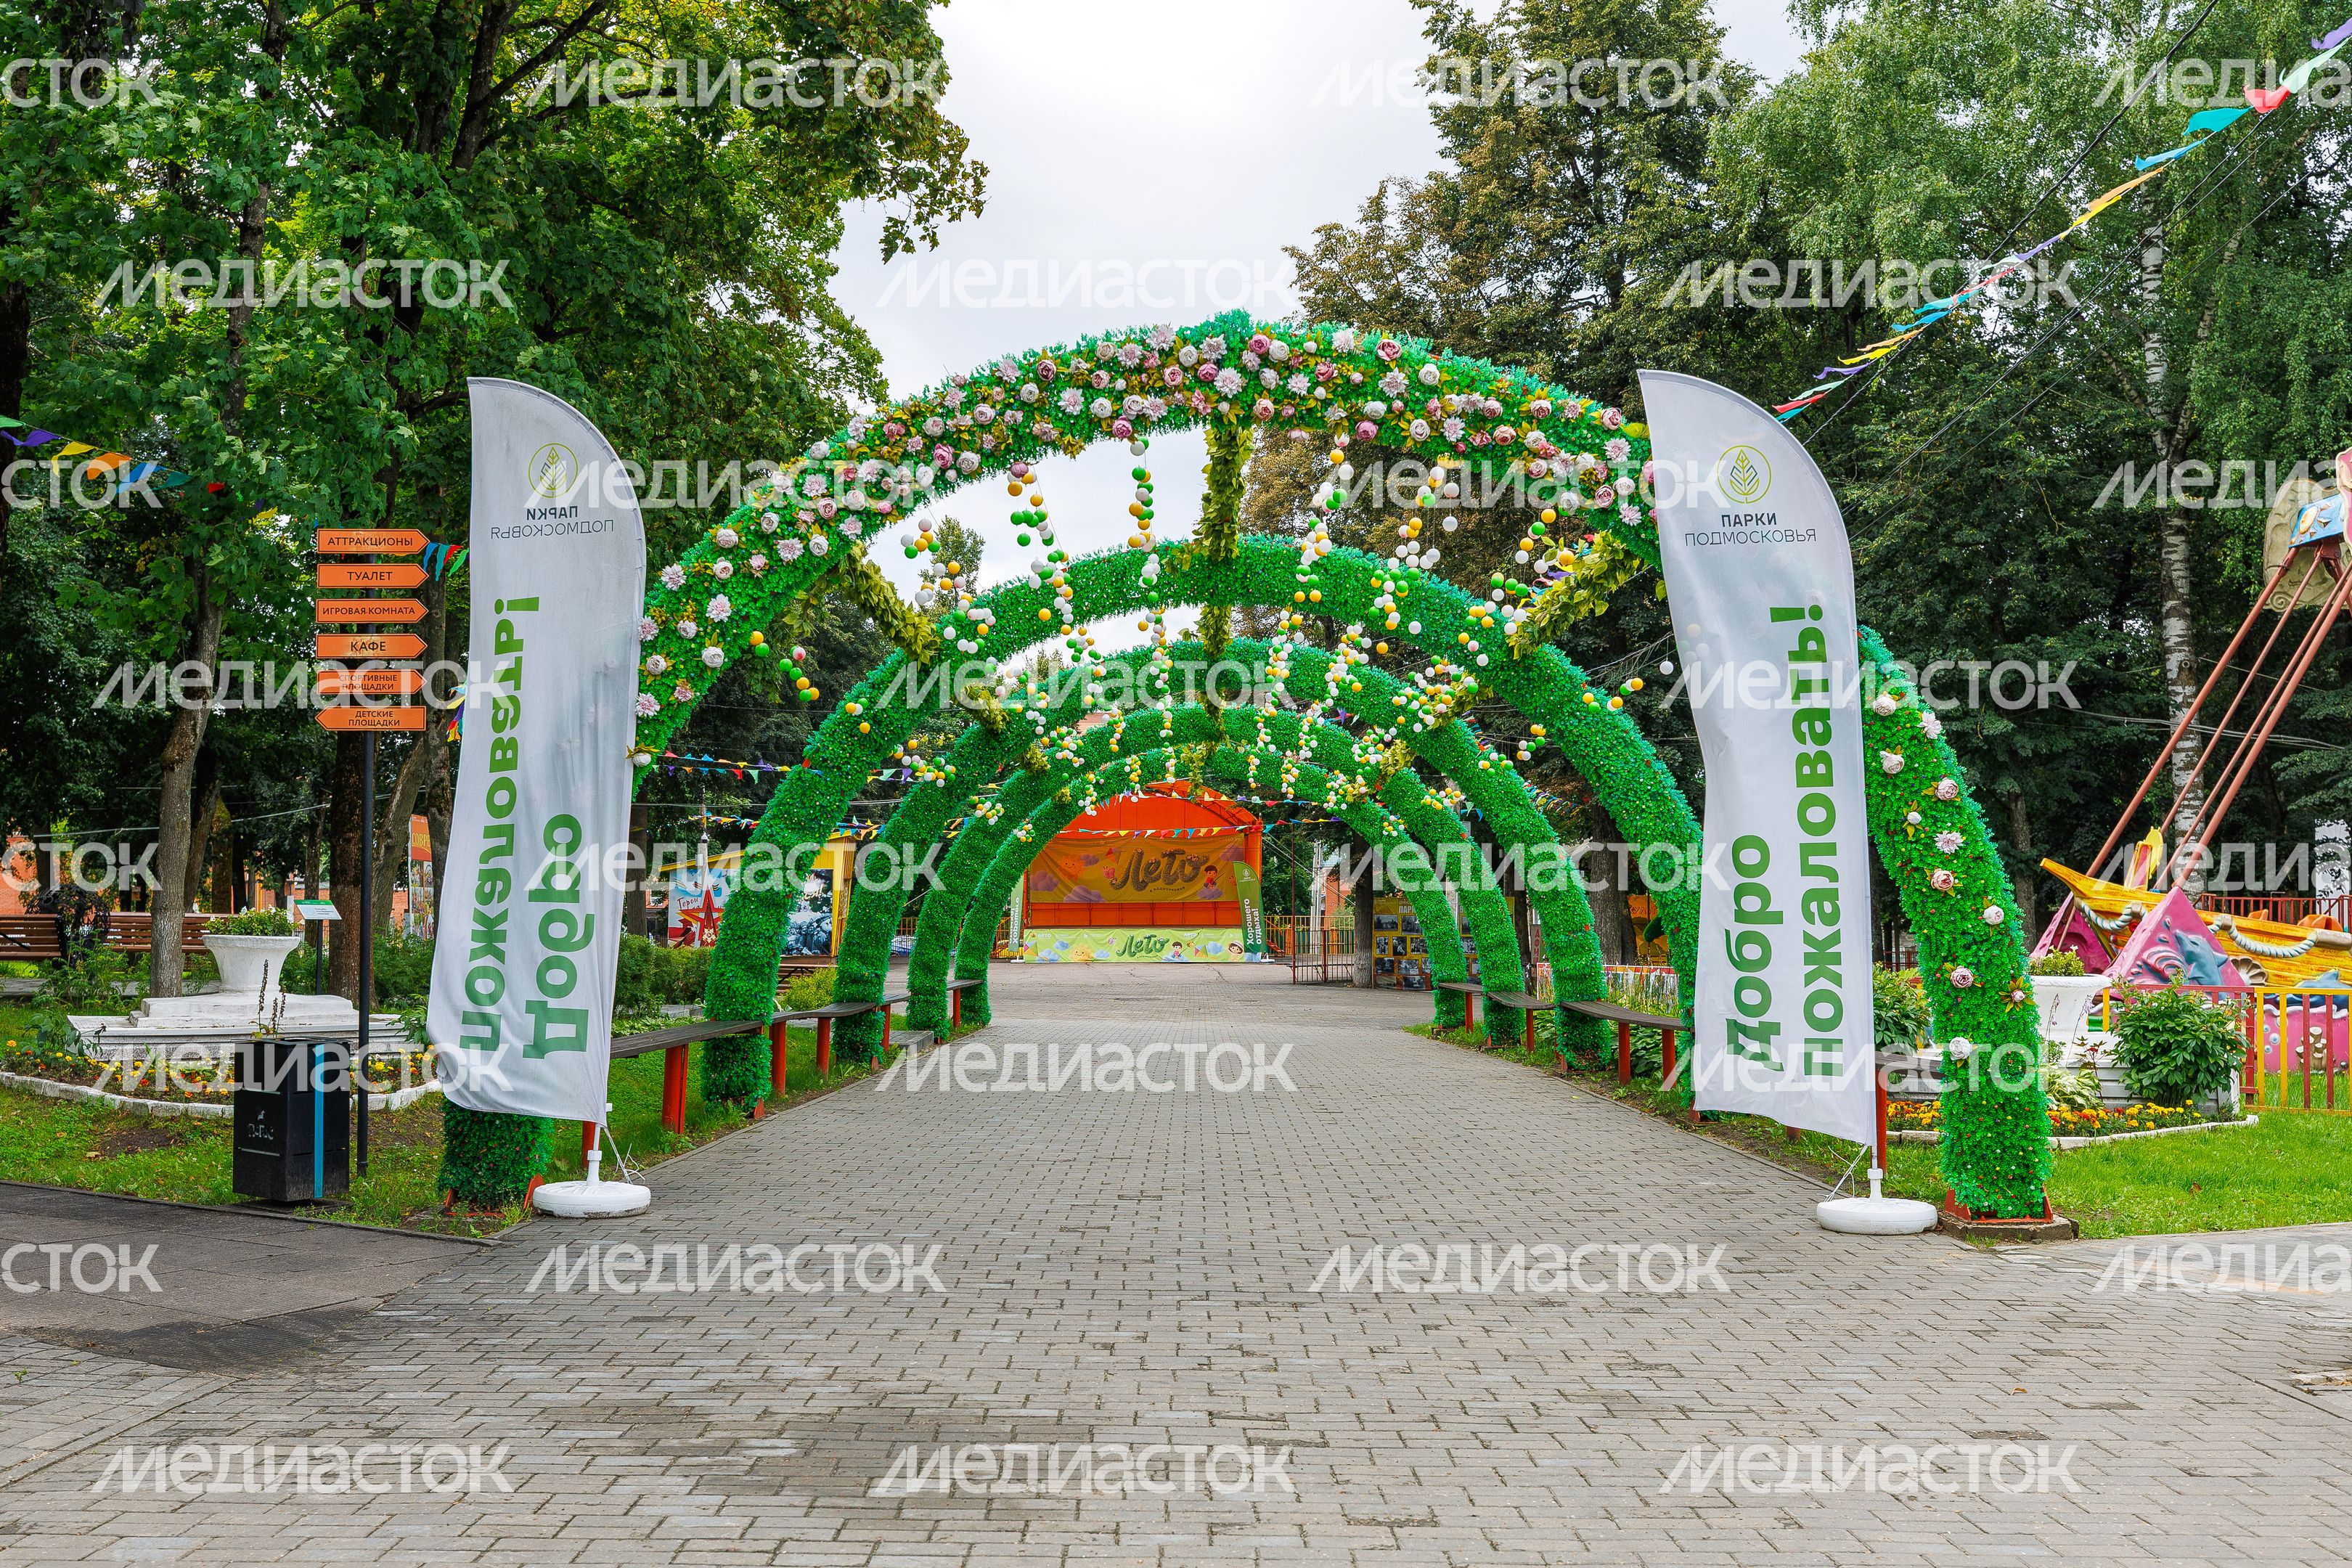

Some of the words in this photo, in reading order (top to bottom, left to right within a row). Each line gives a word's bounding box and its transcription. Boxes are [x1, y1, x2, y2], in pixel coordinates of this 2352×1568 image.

[1721, 513, 1777, 528] ПАРКИ
[327, 537, 413, 547] АТТРАКЦИОНЫ
[1684, 528, 1816, 547] ПОДМОСКОВЬЯ
[347, 571, 393, 581] ТУАЛЕТ
[322, 607, 366, 616] ИГРОВАЯ
[351, 640, 386, 652] КАФЕ
[1769, 603, 1845, 1078] пожаловать!
[1108, 847, 1211, 893] Лето
[1244, 898, 1255, 945] Хорошего
[1116, 933, 1170, 957] Лето
[1724, 834, 1784, 1073] Добро
